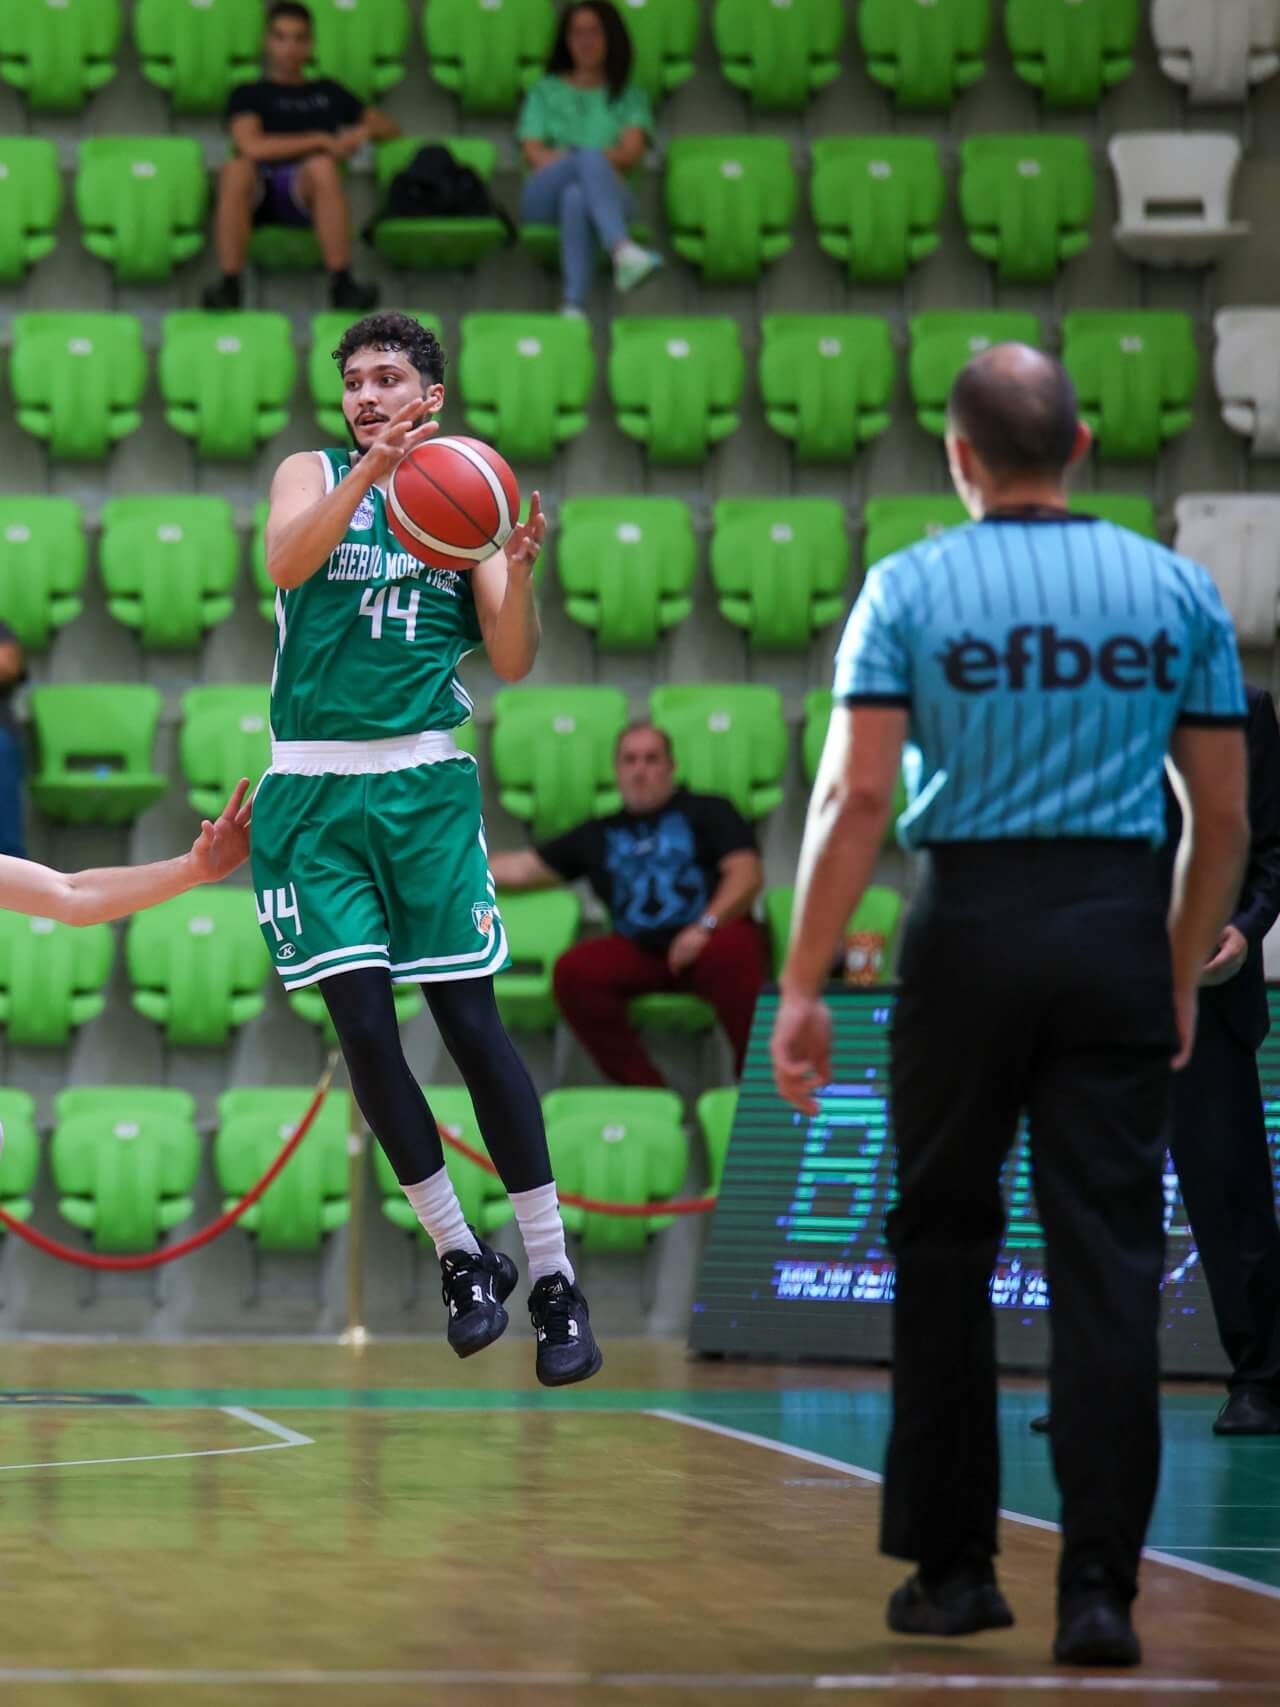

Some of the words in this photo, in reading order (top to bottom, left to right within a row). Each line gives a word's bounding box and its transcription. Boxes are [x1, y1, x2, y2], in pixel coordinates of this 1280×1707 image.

[358, 585, 421, 642] 44
[941, 625, 1180, 693] efbet
[254, 881, 302, 941] 44
